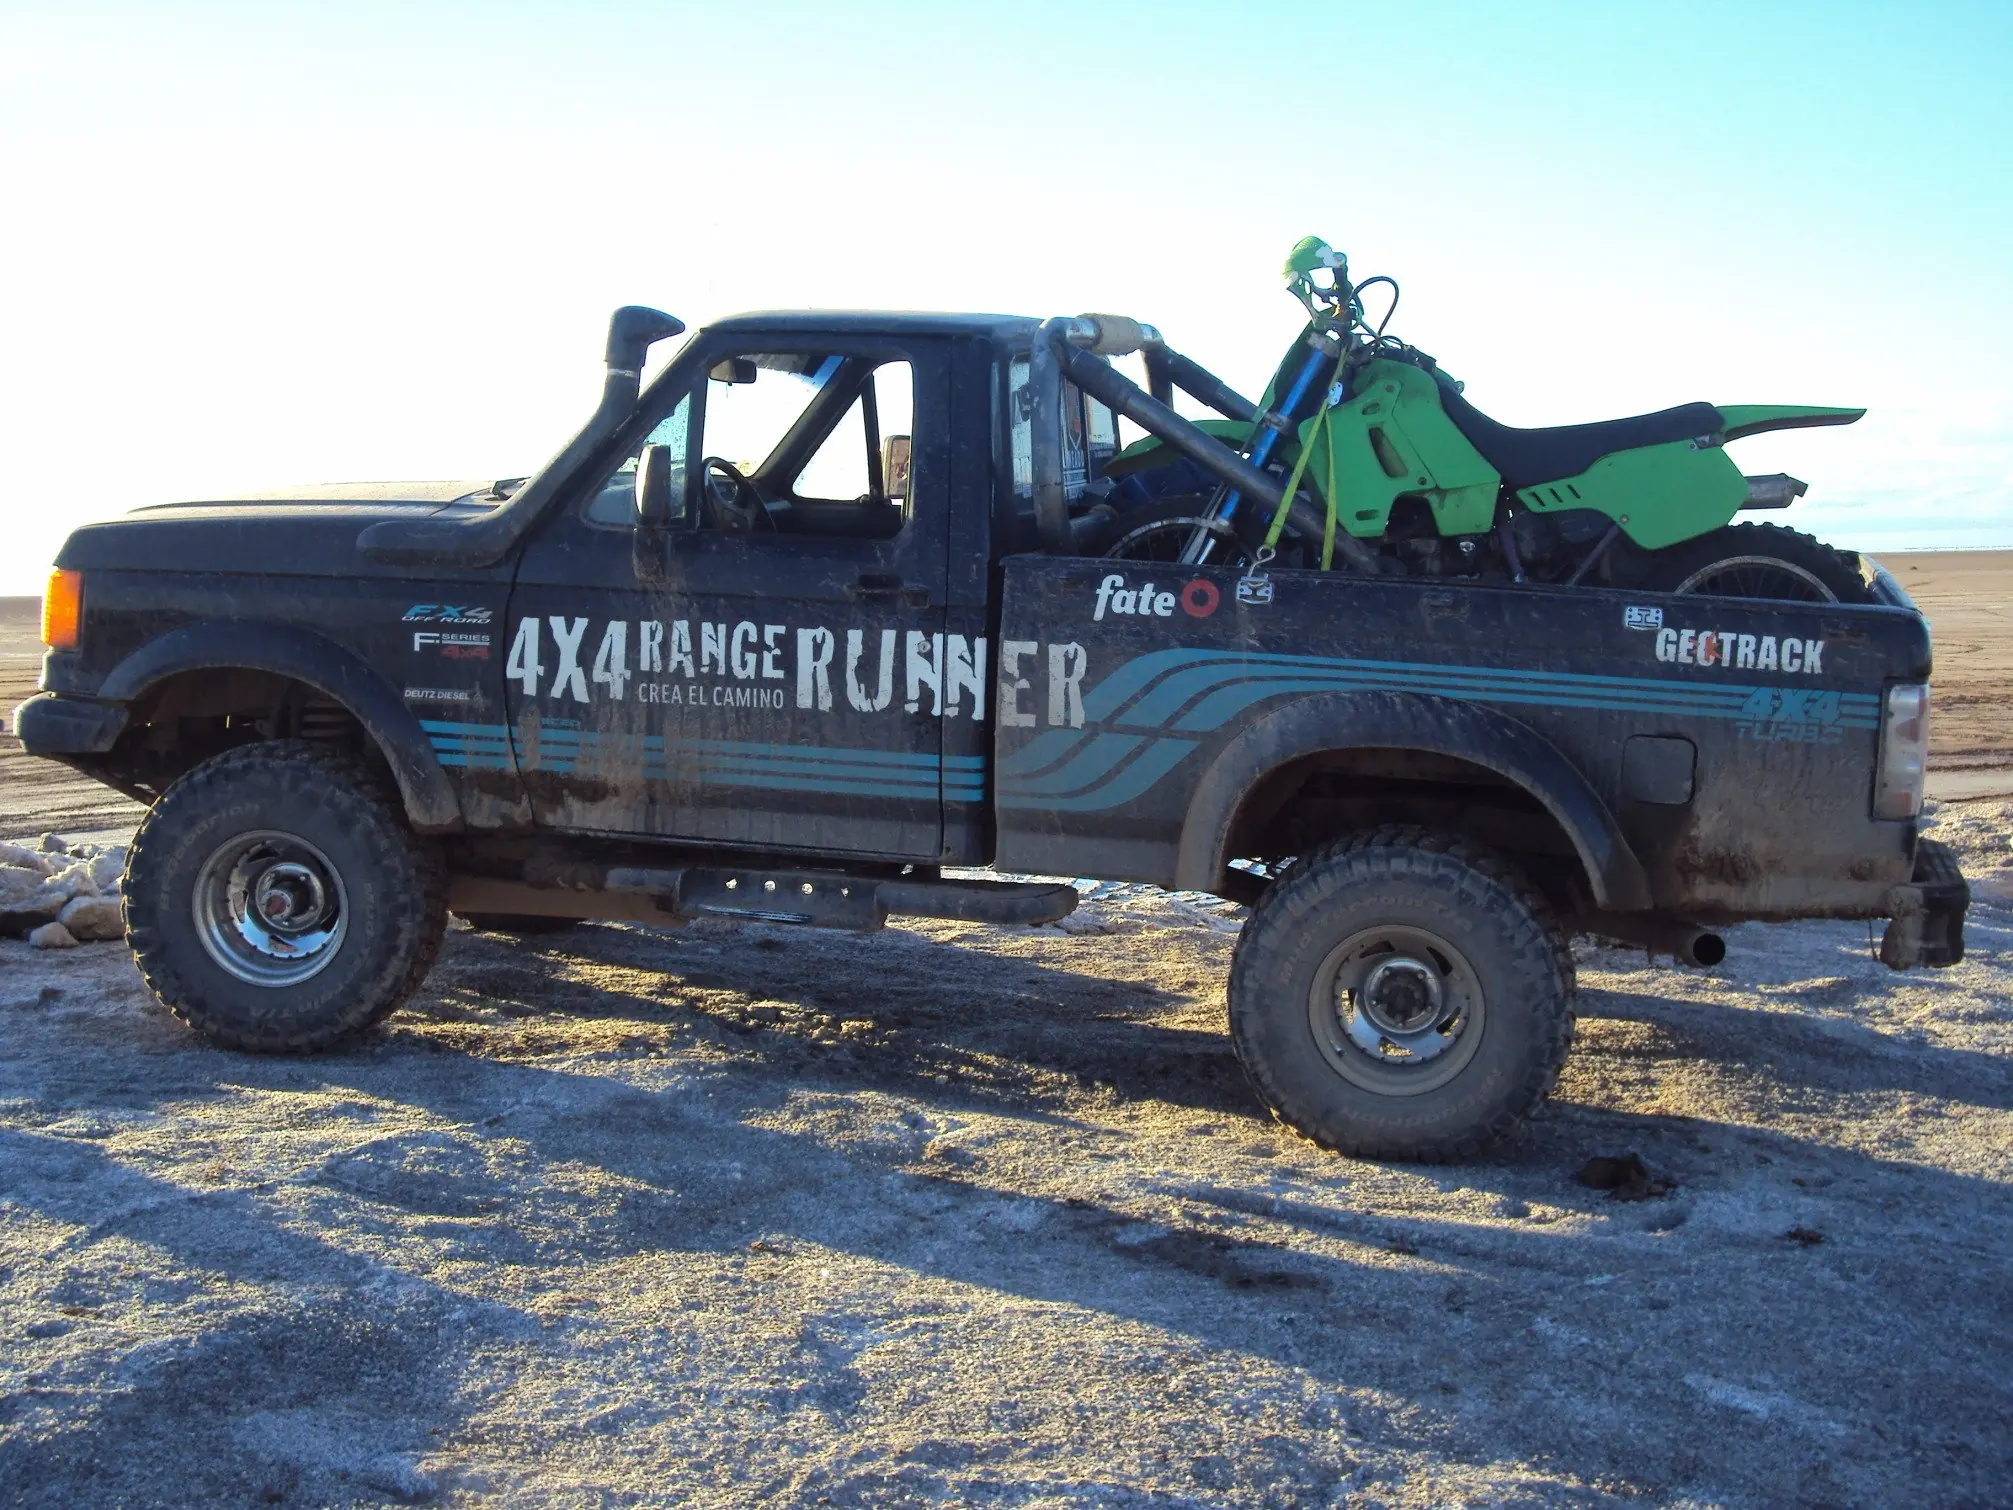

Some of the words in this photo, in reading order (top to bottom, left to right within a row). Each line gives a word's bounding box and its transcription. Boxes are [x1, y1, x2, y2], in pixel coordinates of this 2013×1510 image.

[405, 604, 494, 618] FX4
[1093, 574, 1176, 621] fate
[506, 616, 631, 703] 4X4
[639, 619, 786, 679] RANGE
[796, 626, 1088, 729] RUNNER
[404, 689, 436, 699] DEUTZ
[437, 691, 470, 700] DIESEL
[638, 683, 682, 704] CREA
[688, 686, 707, 706] EL
[712, 686, 784, 710] CAMINO
[1740, 686, 1844, 723] 4X4
[1736, 721, 1844, 744] TURBO
